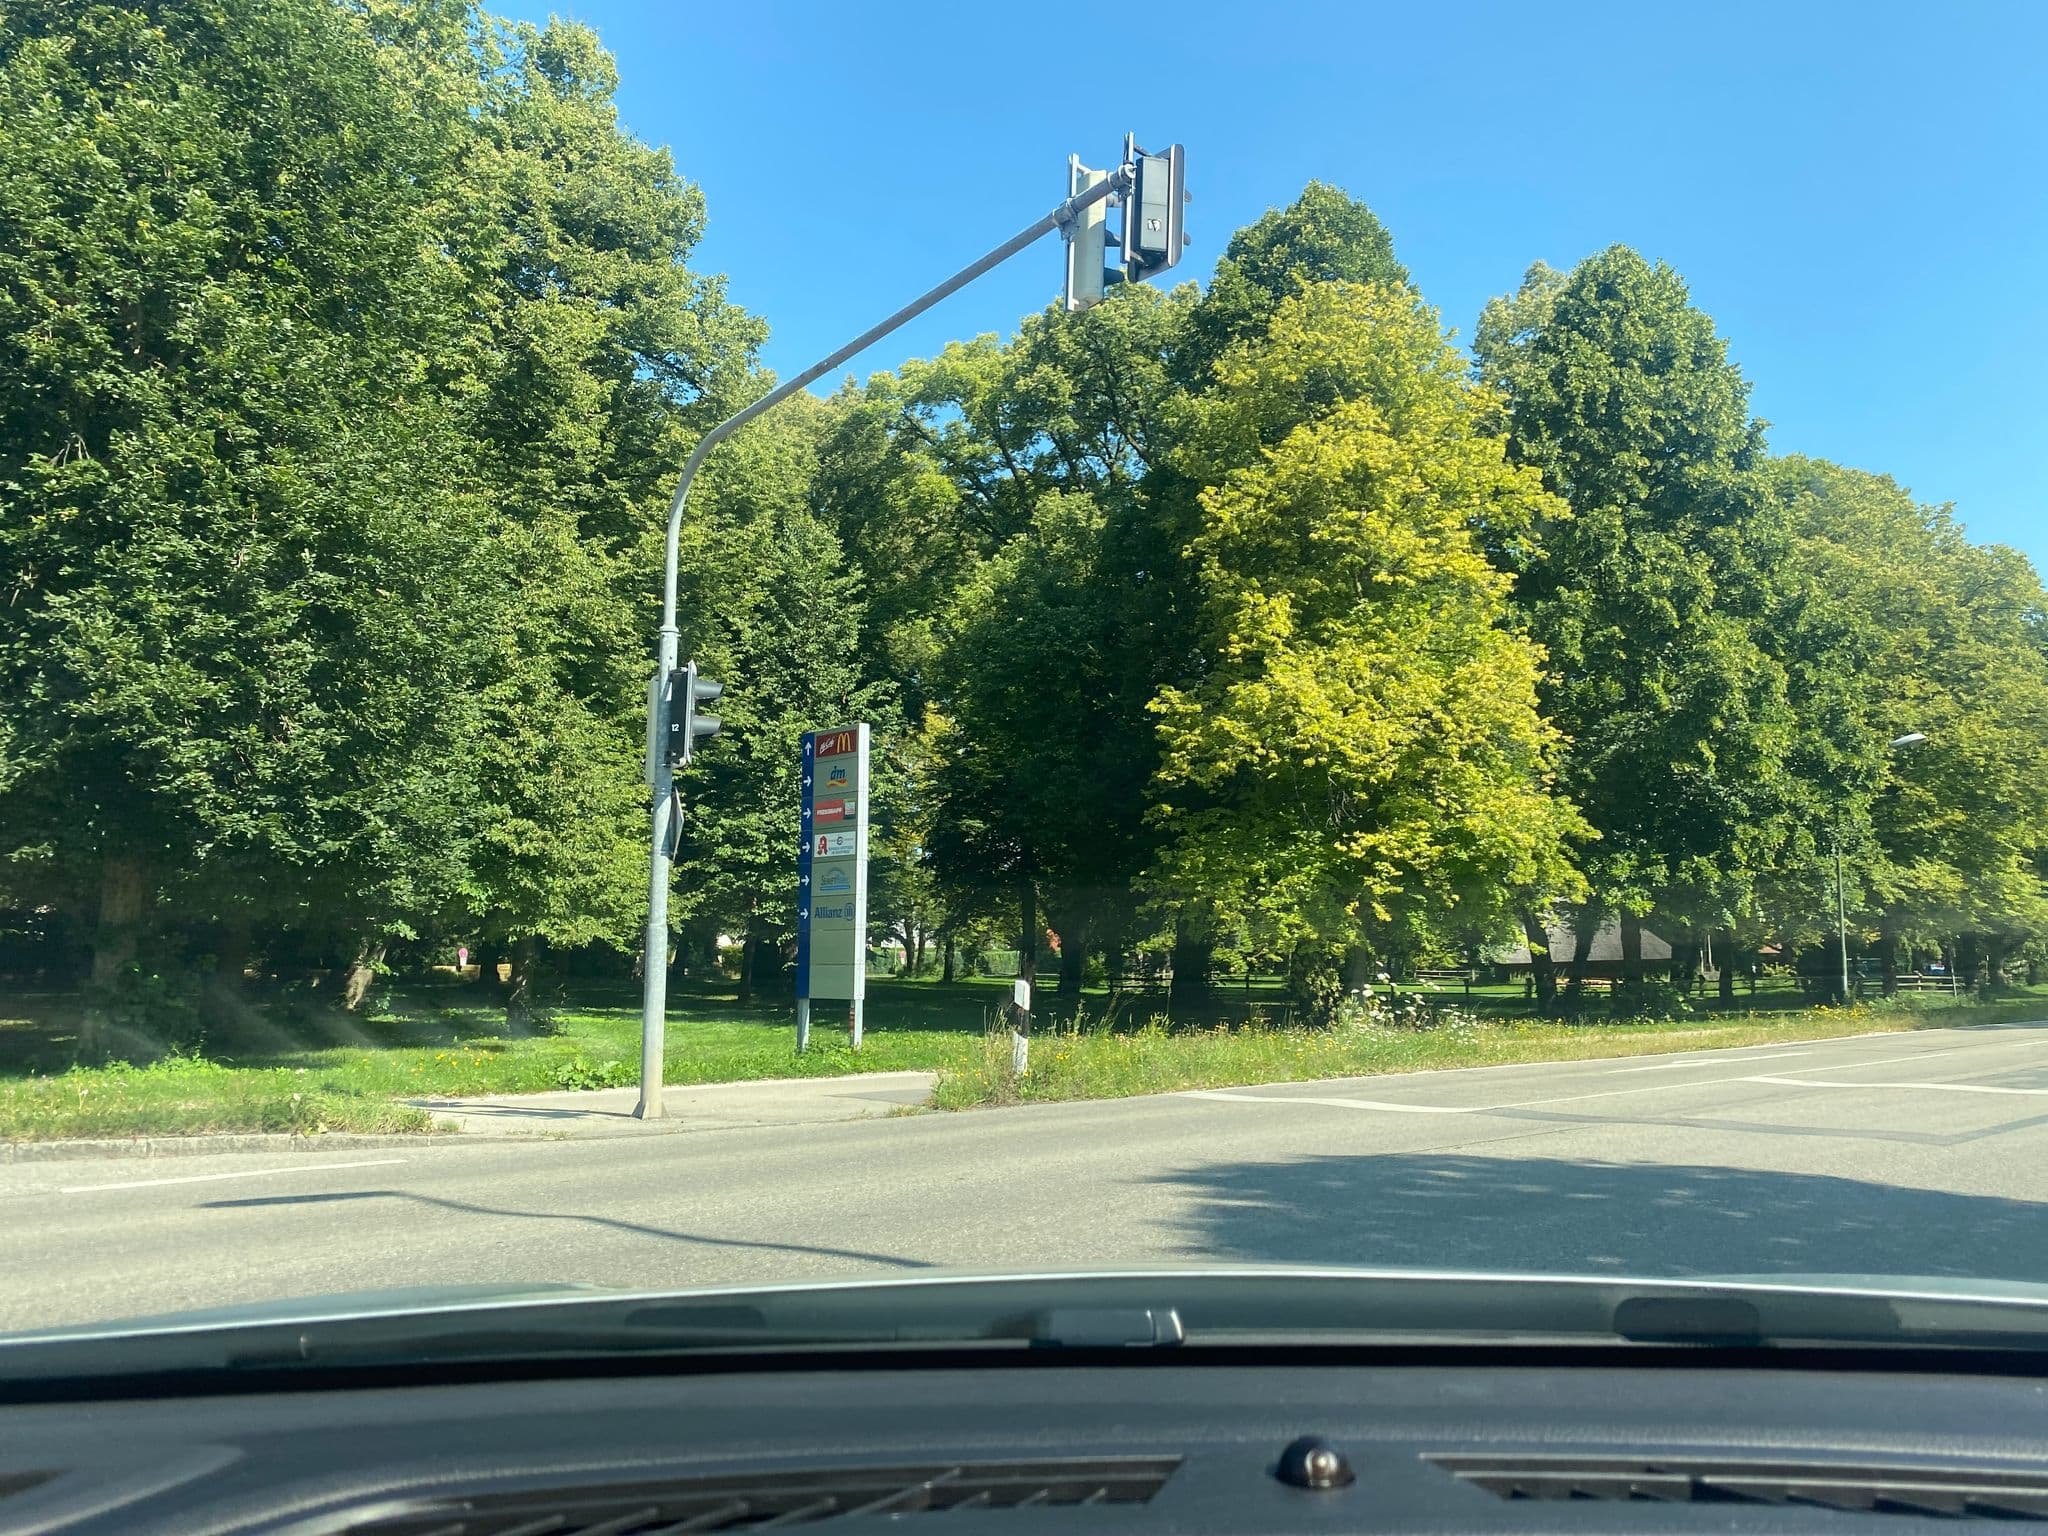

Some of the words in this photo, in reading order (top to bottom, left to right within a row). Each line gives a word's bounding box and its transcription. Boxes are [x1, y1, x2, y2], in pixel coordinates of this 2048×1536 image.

[837, 732, 851, 753] M
[830, 765, 846, 780] dm
[815, 906, 842, 919] Allianz
